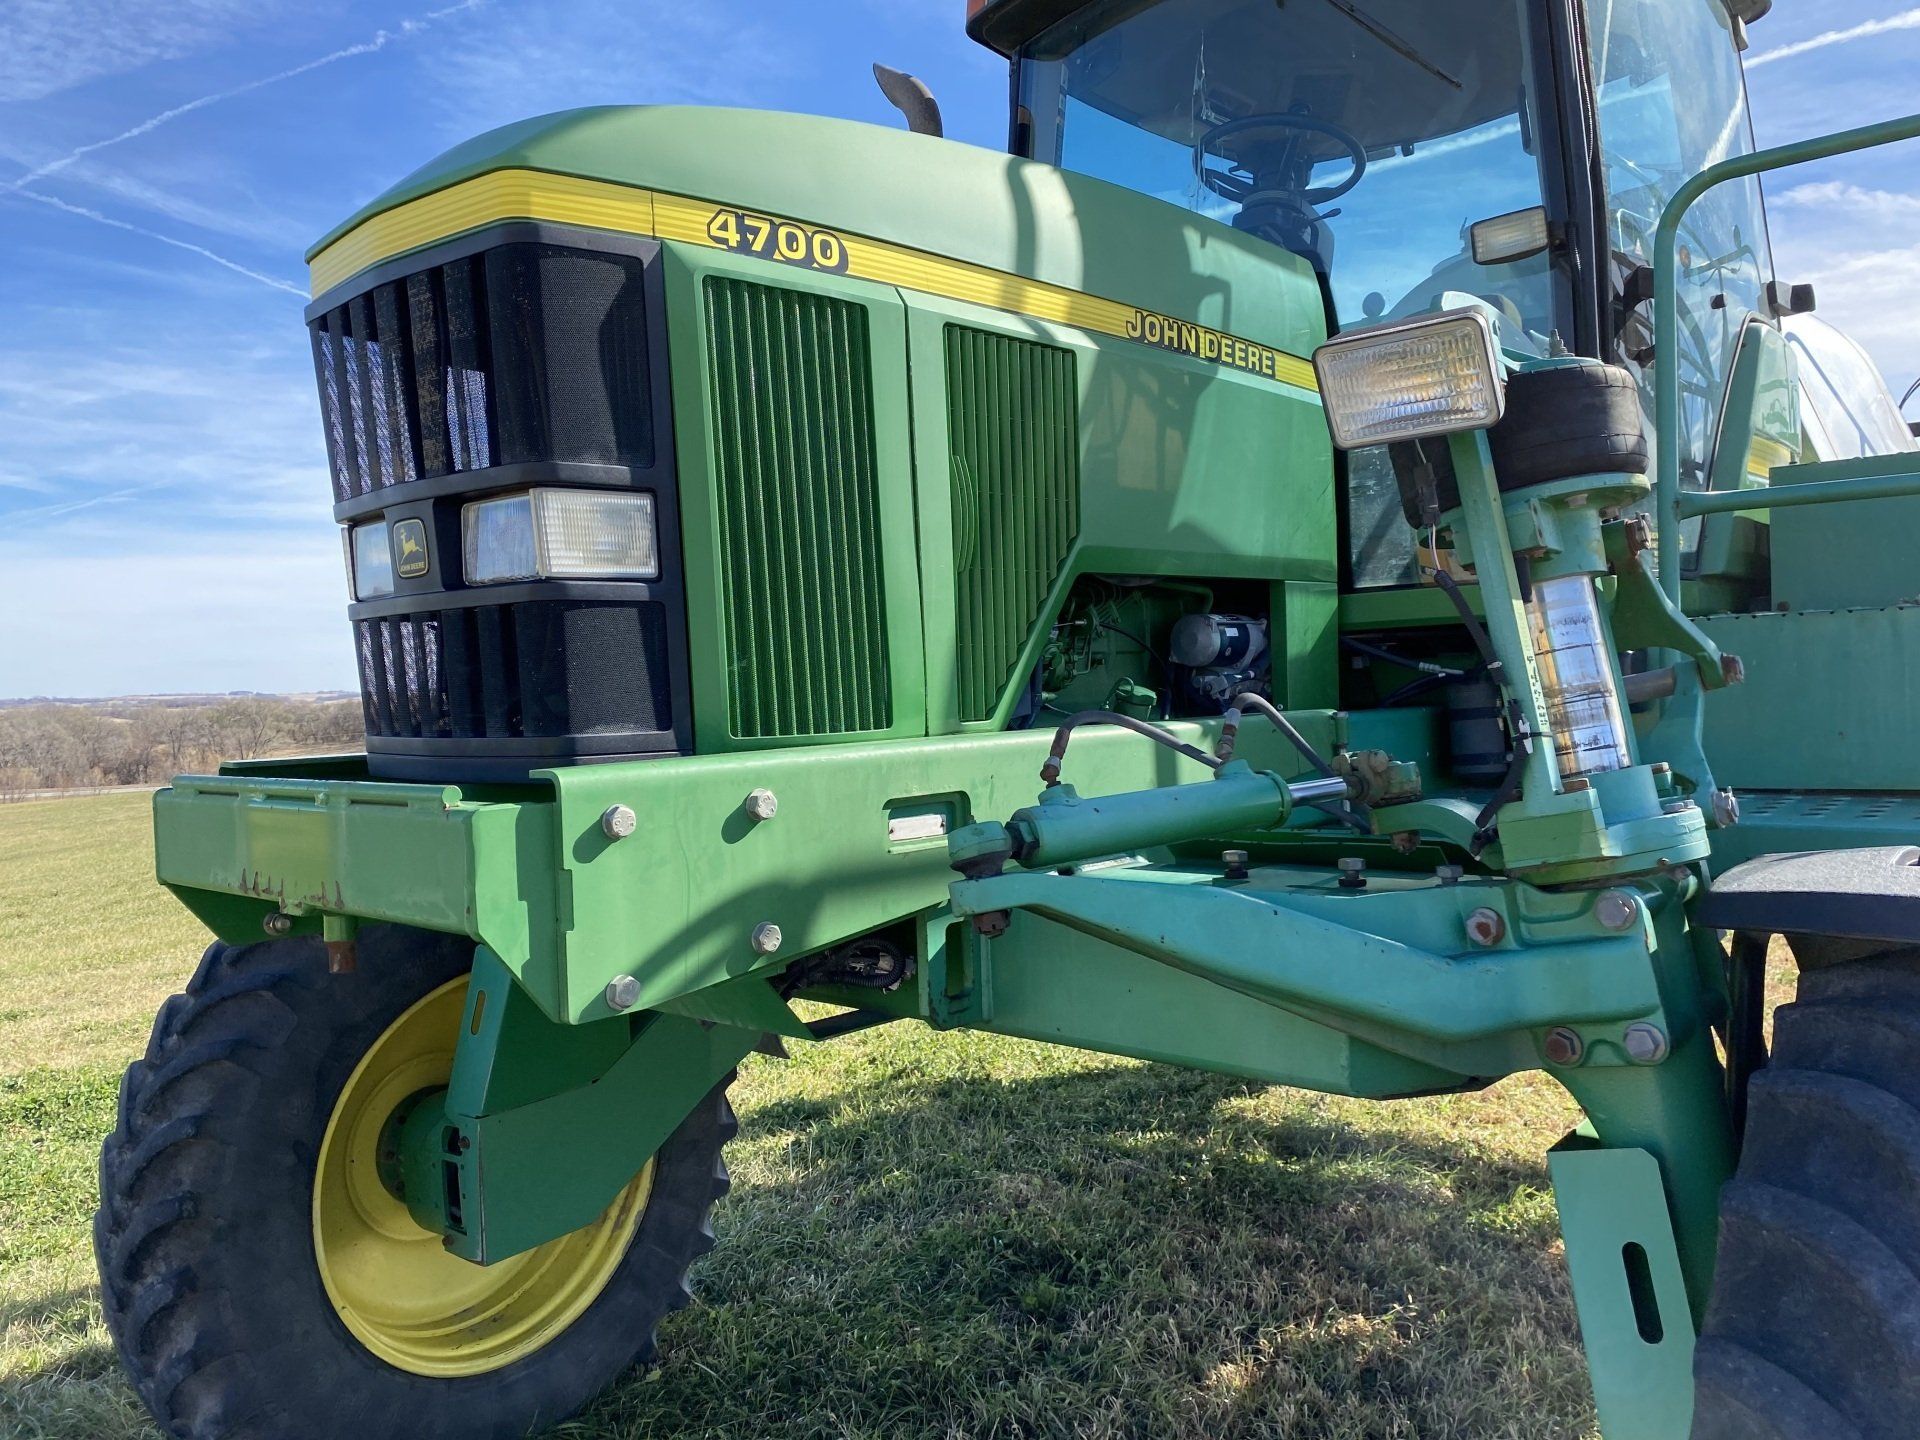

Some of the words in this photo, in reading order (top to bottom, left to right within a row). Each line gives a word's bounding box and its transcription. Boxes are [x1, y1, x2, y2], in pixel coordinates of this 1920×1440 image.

[707, 209, 845, 271] 4700
[1126, 310, 1198, 355] JOHN
[1204, 331, 1274, 376] DEERE
[410, 561, 425, 570] DEERE
